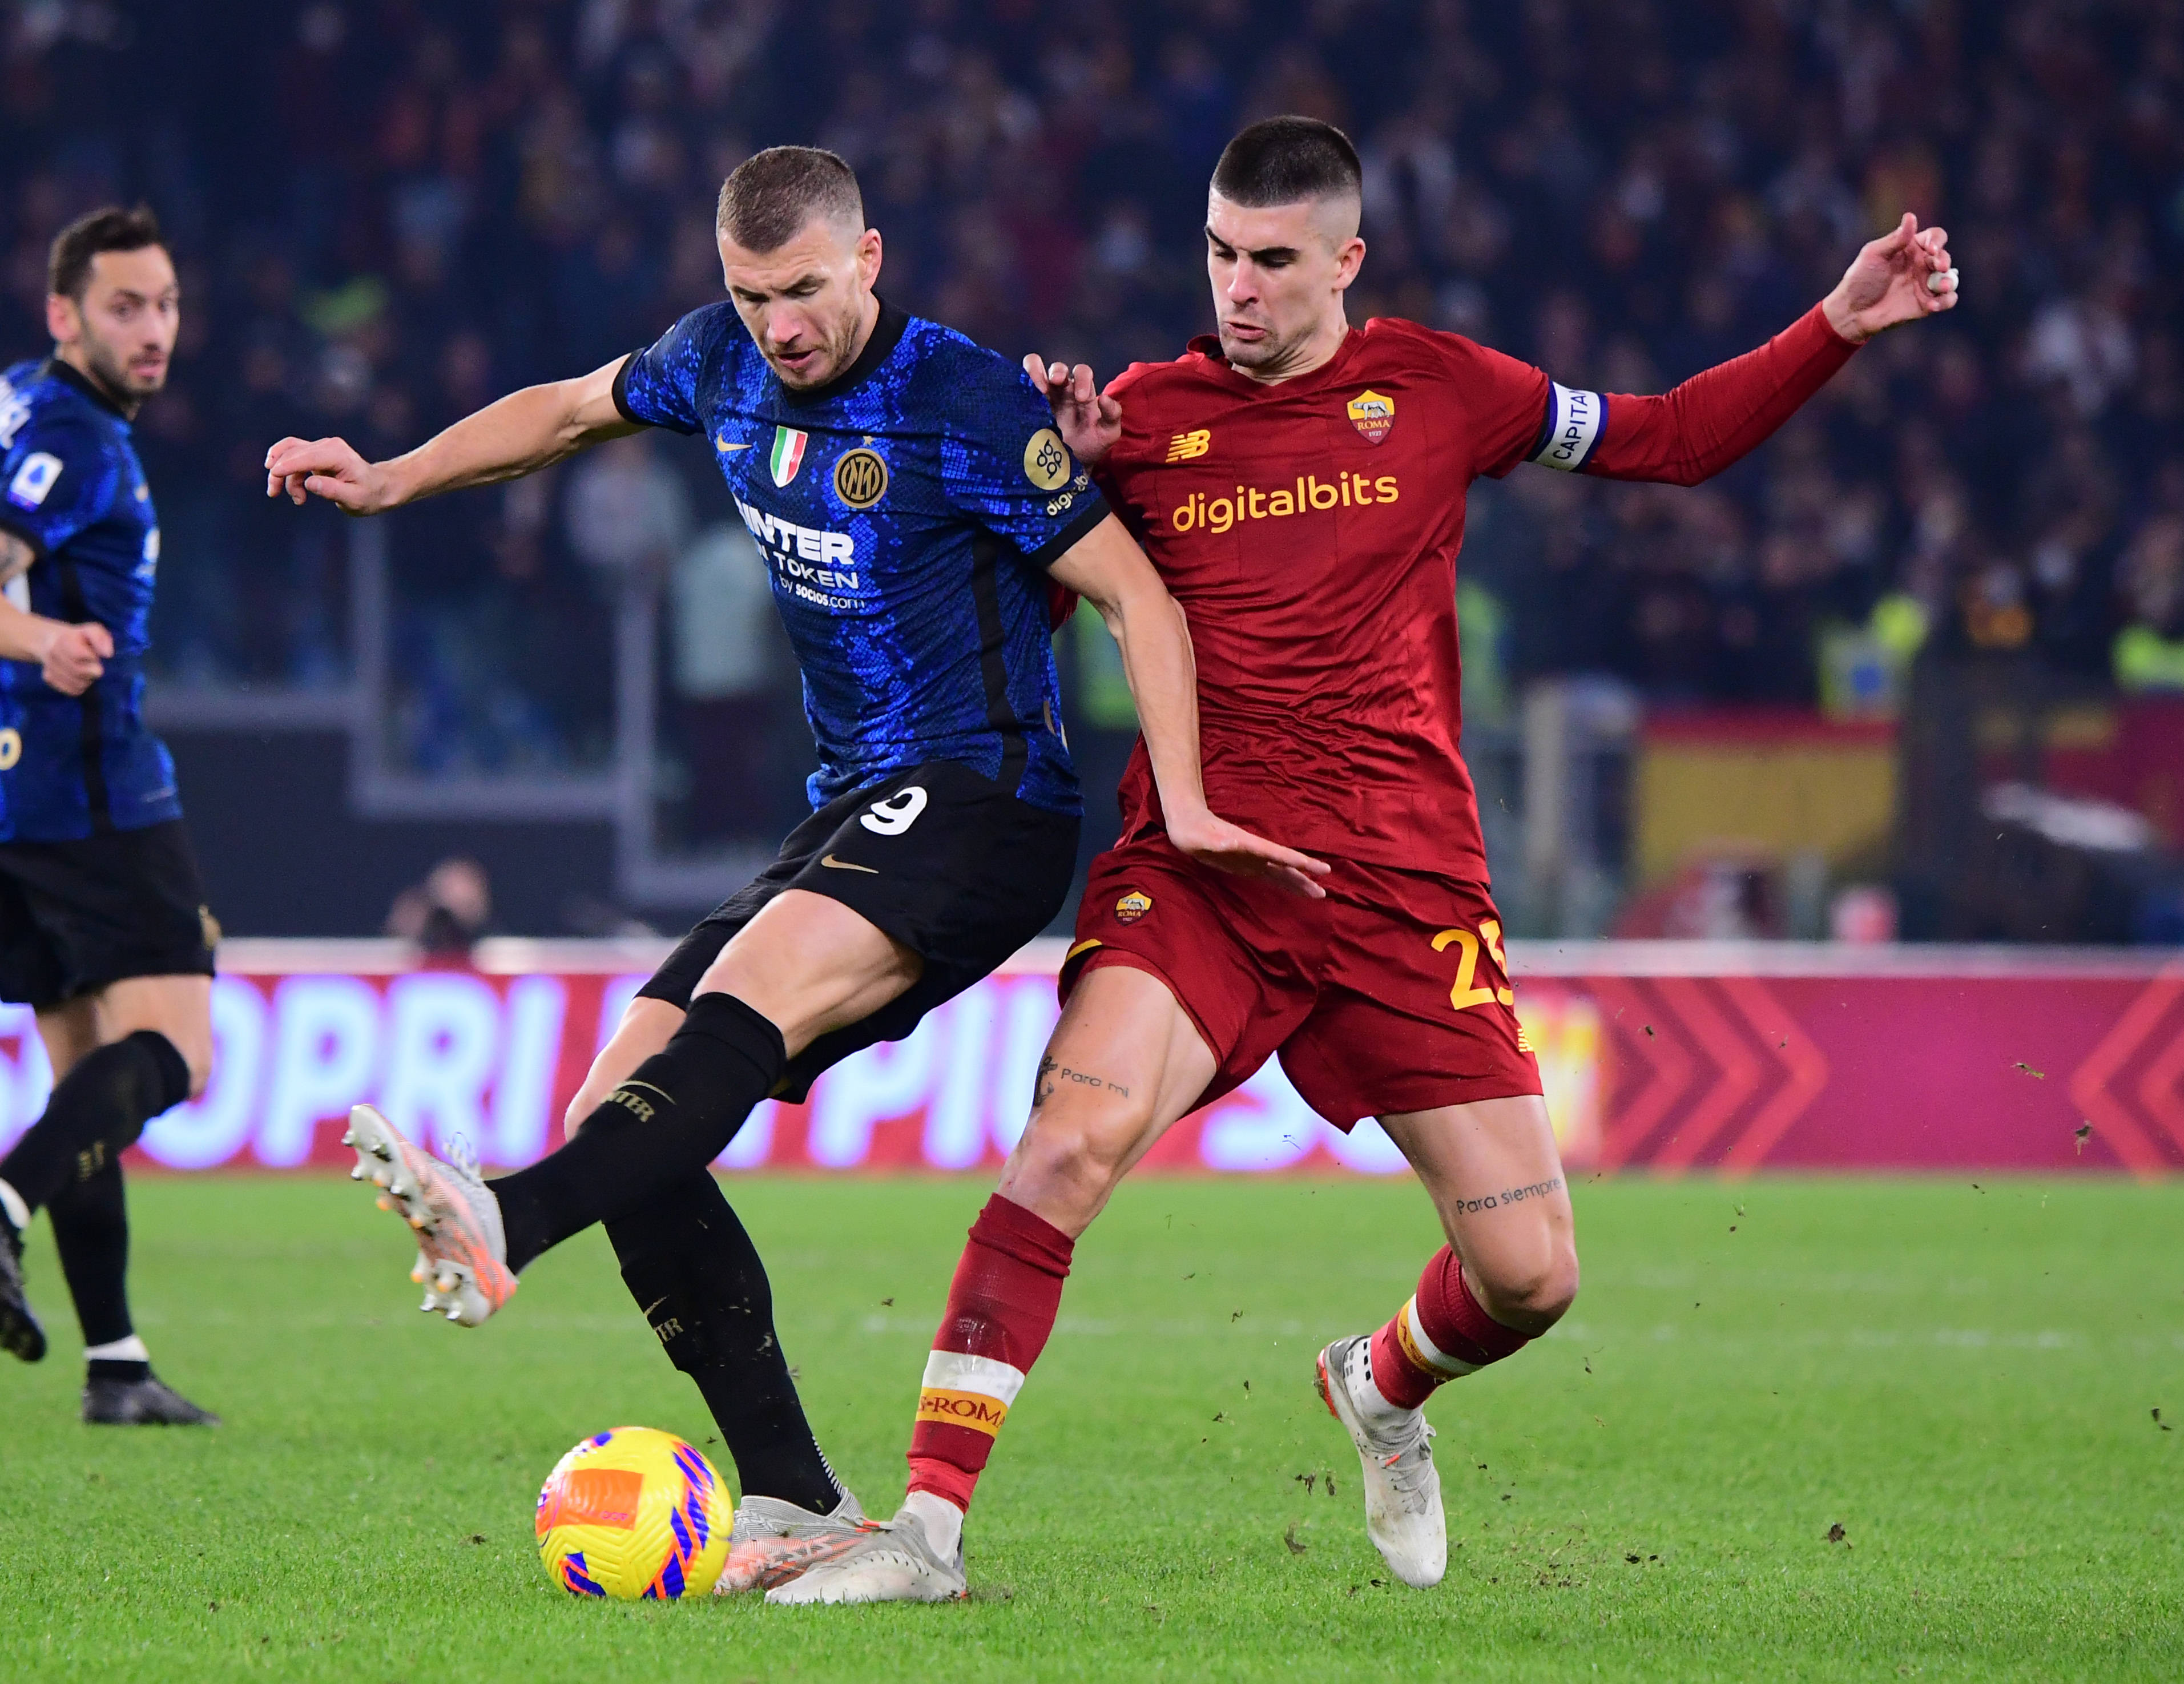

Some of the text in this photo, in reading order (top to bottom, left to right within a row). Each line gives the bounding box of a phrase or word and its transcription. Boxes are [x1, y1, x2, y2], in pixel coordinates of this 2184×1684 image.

[1357, 420, 1391, 430] ROMA
[1172, 471, 1399, 534] digitalbits
[772, 551, 859, 590] TOKEN
[779, 574, 793, 594] by
[860, 786, 928, 836] 9
[1456, 1178, 1562, 1215] Para siempre
